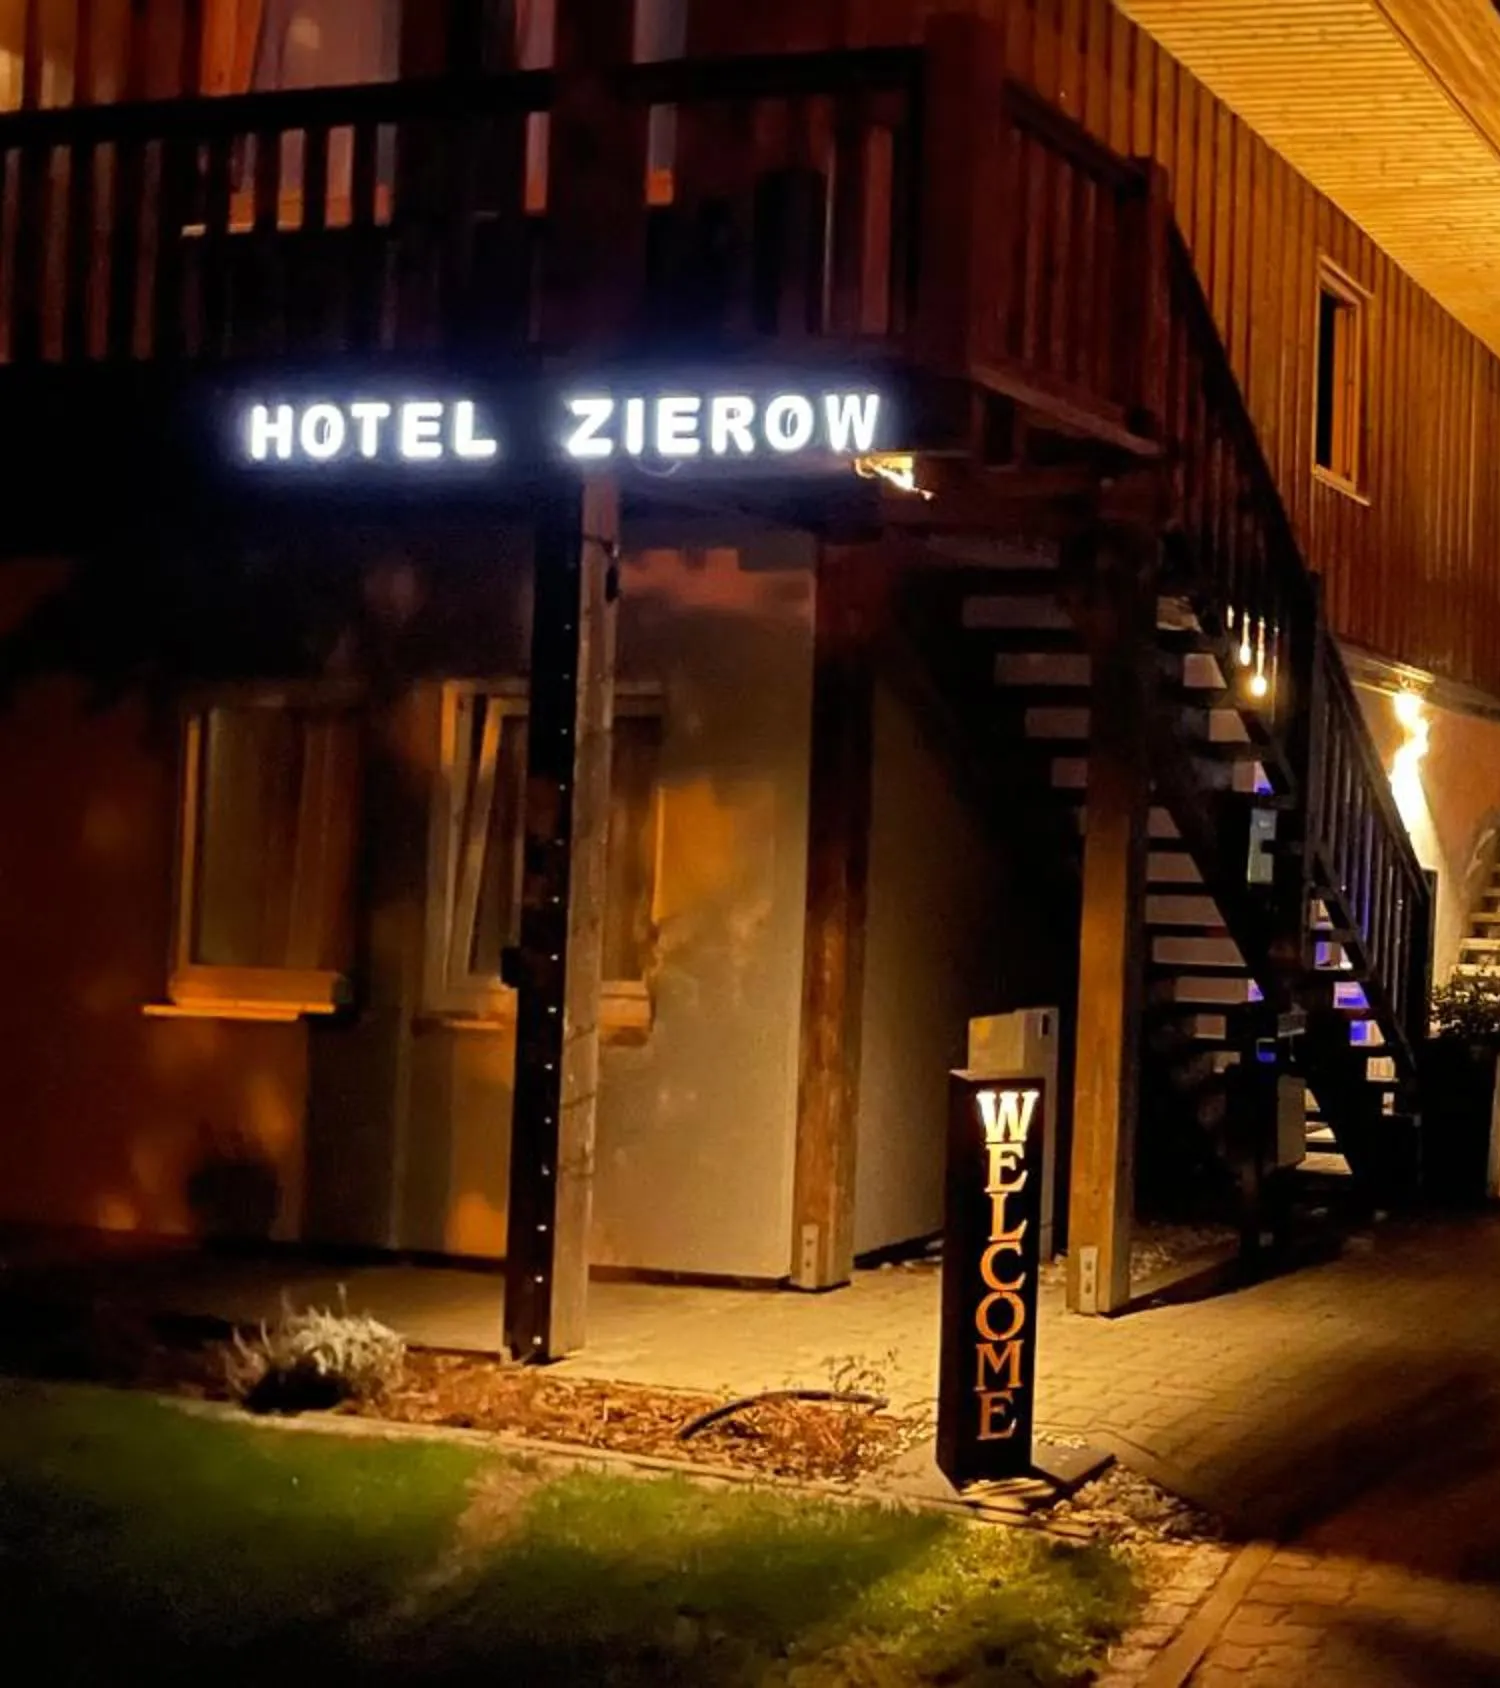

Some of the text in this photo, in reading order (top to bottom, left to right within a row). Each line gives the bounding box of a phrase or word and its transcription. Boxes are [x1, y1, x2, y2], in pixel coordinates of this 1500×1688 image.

[249, 393, 881, 461] HOTEL ZIEROW
[974, 1089, 1040, 1442] WELCOME
